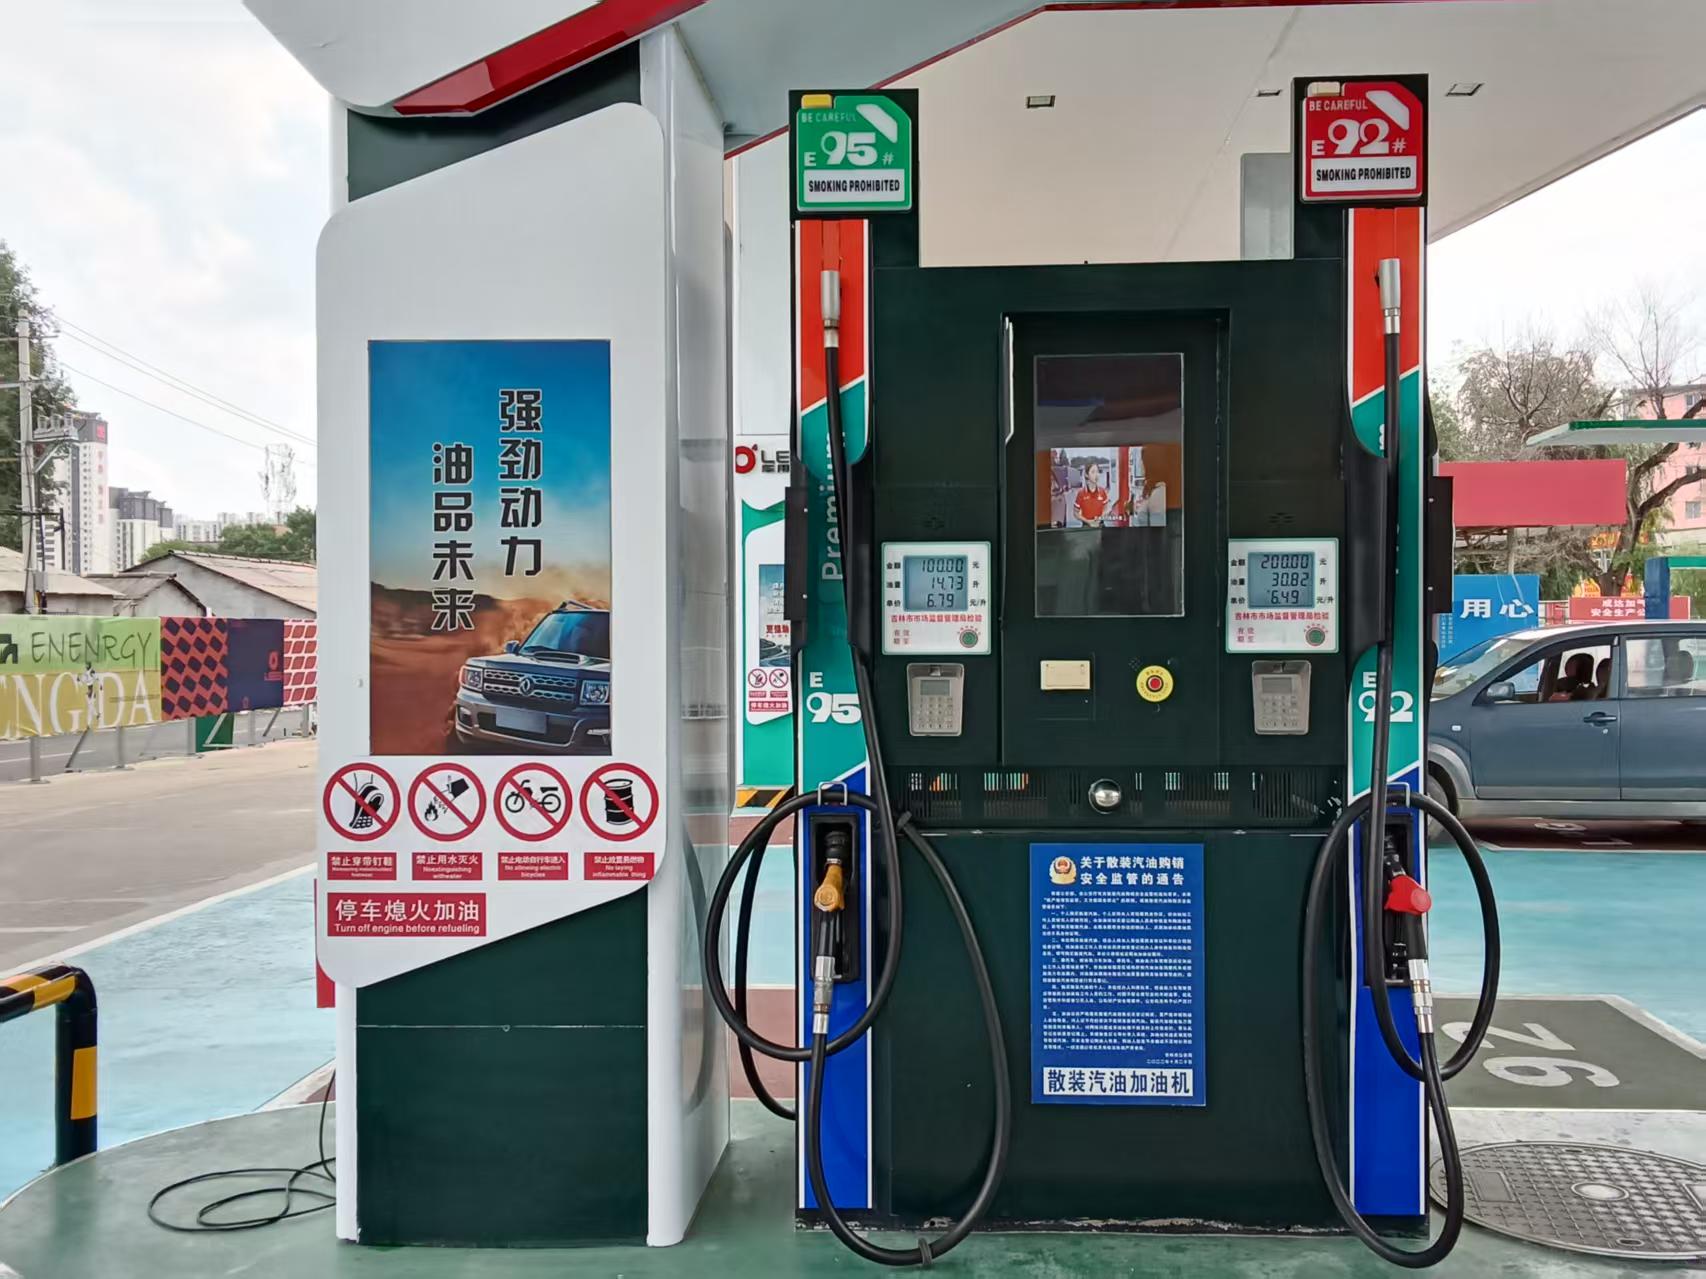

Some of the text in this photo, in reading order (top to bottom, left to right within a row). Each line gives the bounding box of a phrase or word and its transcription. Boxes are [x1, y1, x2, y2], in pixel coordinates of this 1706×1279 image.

[1309, 99, 1368, 112] BE CAREFUL
[801, 112, 813, 123] BE
[1316, 166, 1412, 182] SMOKING PROHIBITED
[808, 179, 900, 193] SMOKING PROHIBITED
[499, 388, 543, 578] 强劲动力
[431, 441, 475, 631] 油品未来
[921, 558, 964, 573] 100.00
[931, 576, 964, 591] 14.73
[1271, 572, 1310, 587] 30.82
[926, 593, 955, 609] 6.79
[805, 691, 863, 725] 95
[1357, 689, 1414, 723] 92
[415, 854, 479, 865] 禁止用水灭火
[1079, 856, 1185, 870] 关于散装汽油购销
[1079, 873, 1185, 886] 安全监管的通告
[335, 899, 480, 922] 停车熄火加油
[334, 923, 480, 936] Turn off engine before refueling
[1046, 1069, 1191, 1094] 散装汽油加油机
